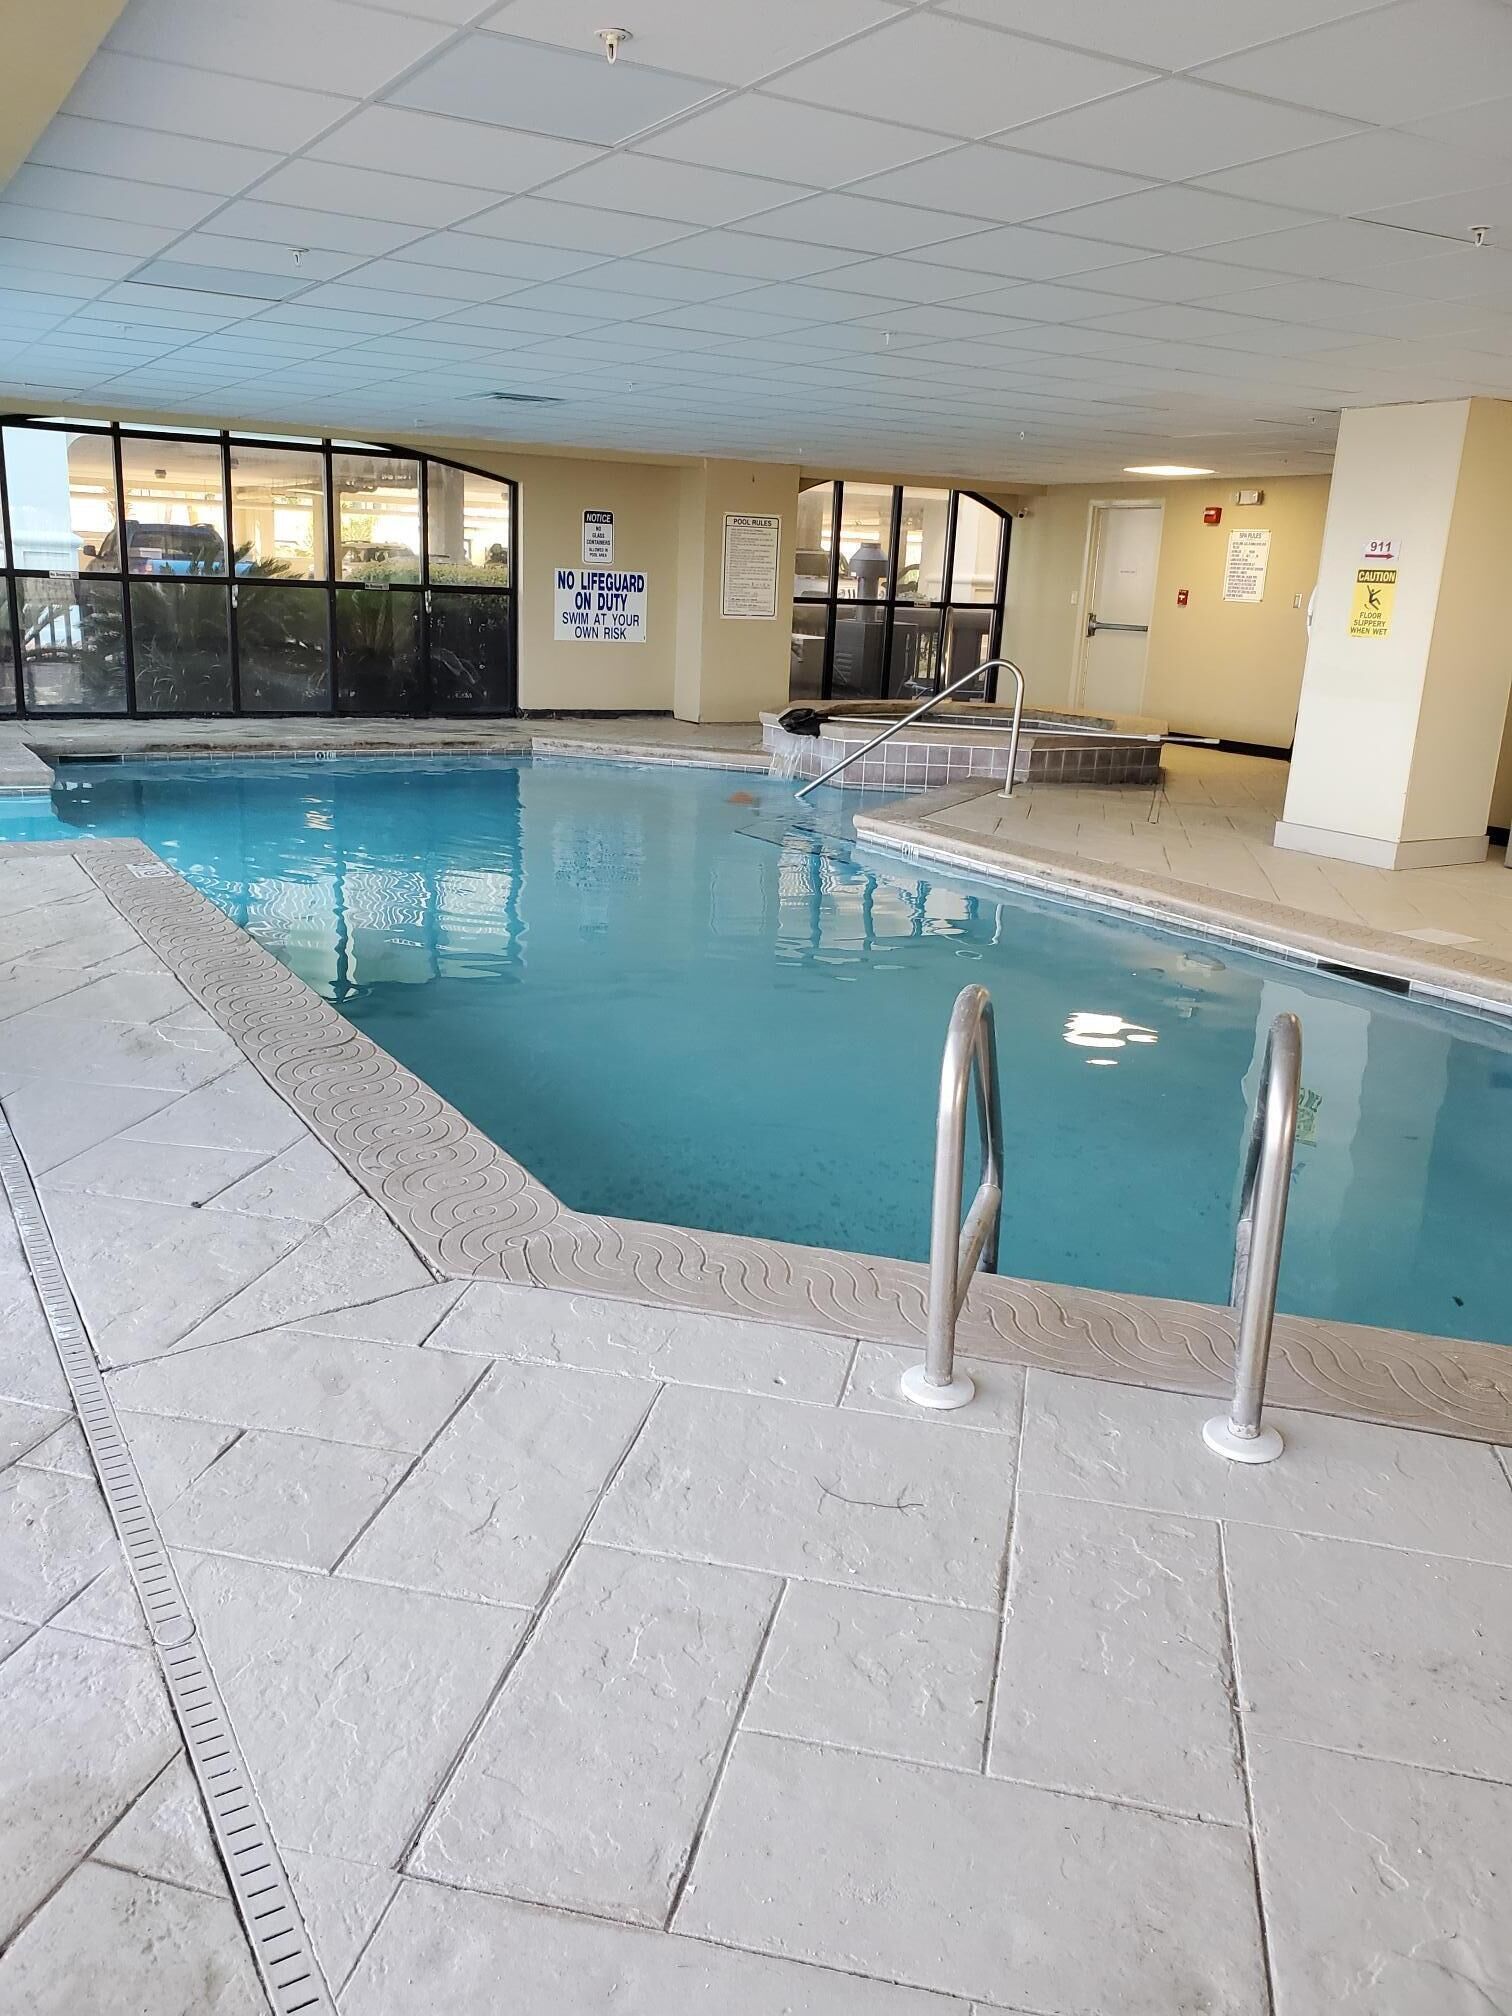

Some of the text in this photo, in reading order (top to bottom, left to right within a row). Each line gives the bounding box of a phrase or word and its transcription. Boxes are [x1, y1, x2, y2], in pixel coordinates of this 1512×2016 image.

[586, 513, 611, 522] NOTICE
[733, 518, 772, 527] POOL RULES
[1370, 541, 1392, 552] 911
[558, 571, 644, 592] NO LIFEGUARD
[1359, 571, 1396, 582] CAUTION
[575, 592, 628, 612] ON DUTY
[562, 612, 640, 626] SWIM AT YOUR
[574, 626, 626, 640] OWN RISK
[1350, 626, 1370, 634] WHEN
[1372, 628, 1388, 636] WET
